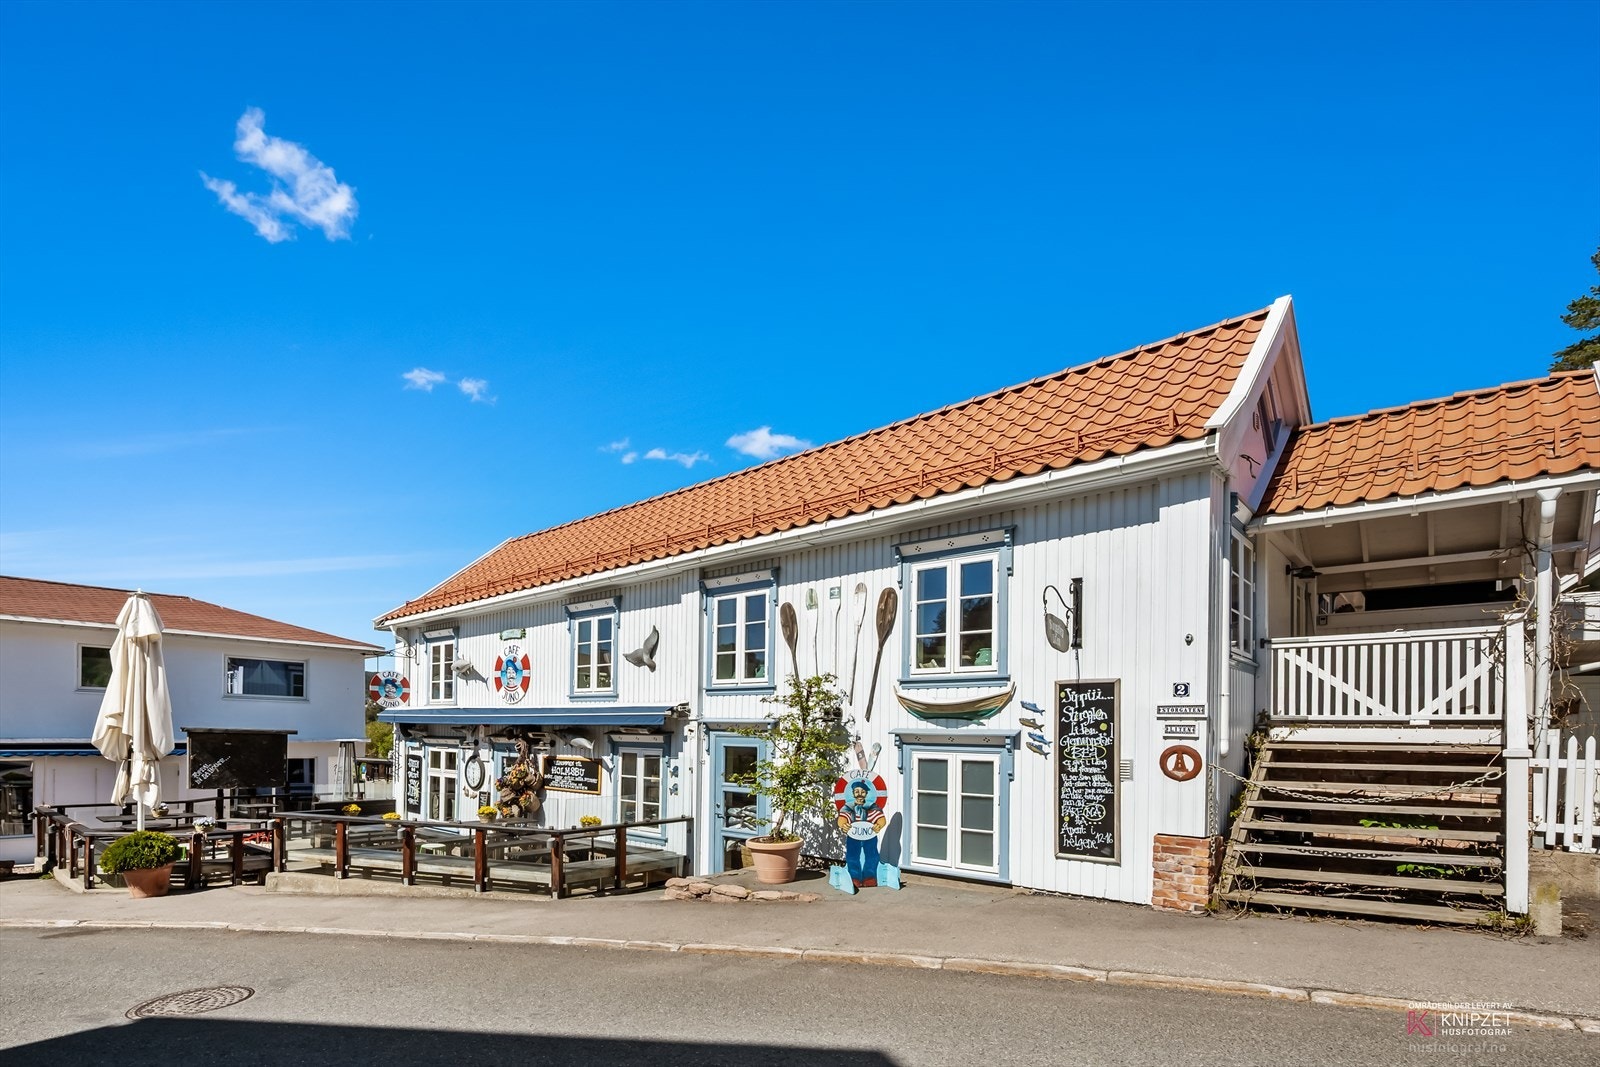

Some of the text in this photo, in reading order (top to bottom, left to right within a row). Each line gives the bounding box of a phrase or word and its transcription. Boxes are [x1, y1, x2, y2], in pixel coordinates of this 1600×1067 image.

[503, 644, 521, 656] CAFE
[382, 671, 400, 679] CAFE
[1176, 684, 1186, 695] 2
[502, 690, 520, 703] JUNO
[381, 700, 400, 708] JUNO
[551, 766, 586, 777] HOLMSBU
[851, 826, 873, 836] JUNO
